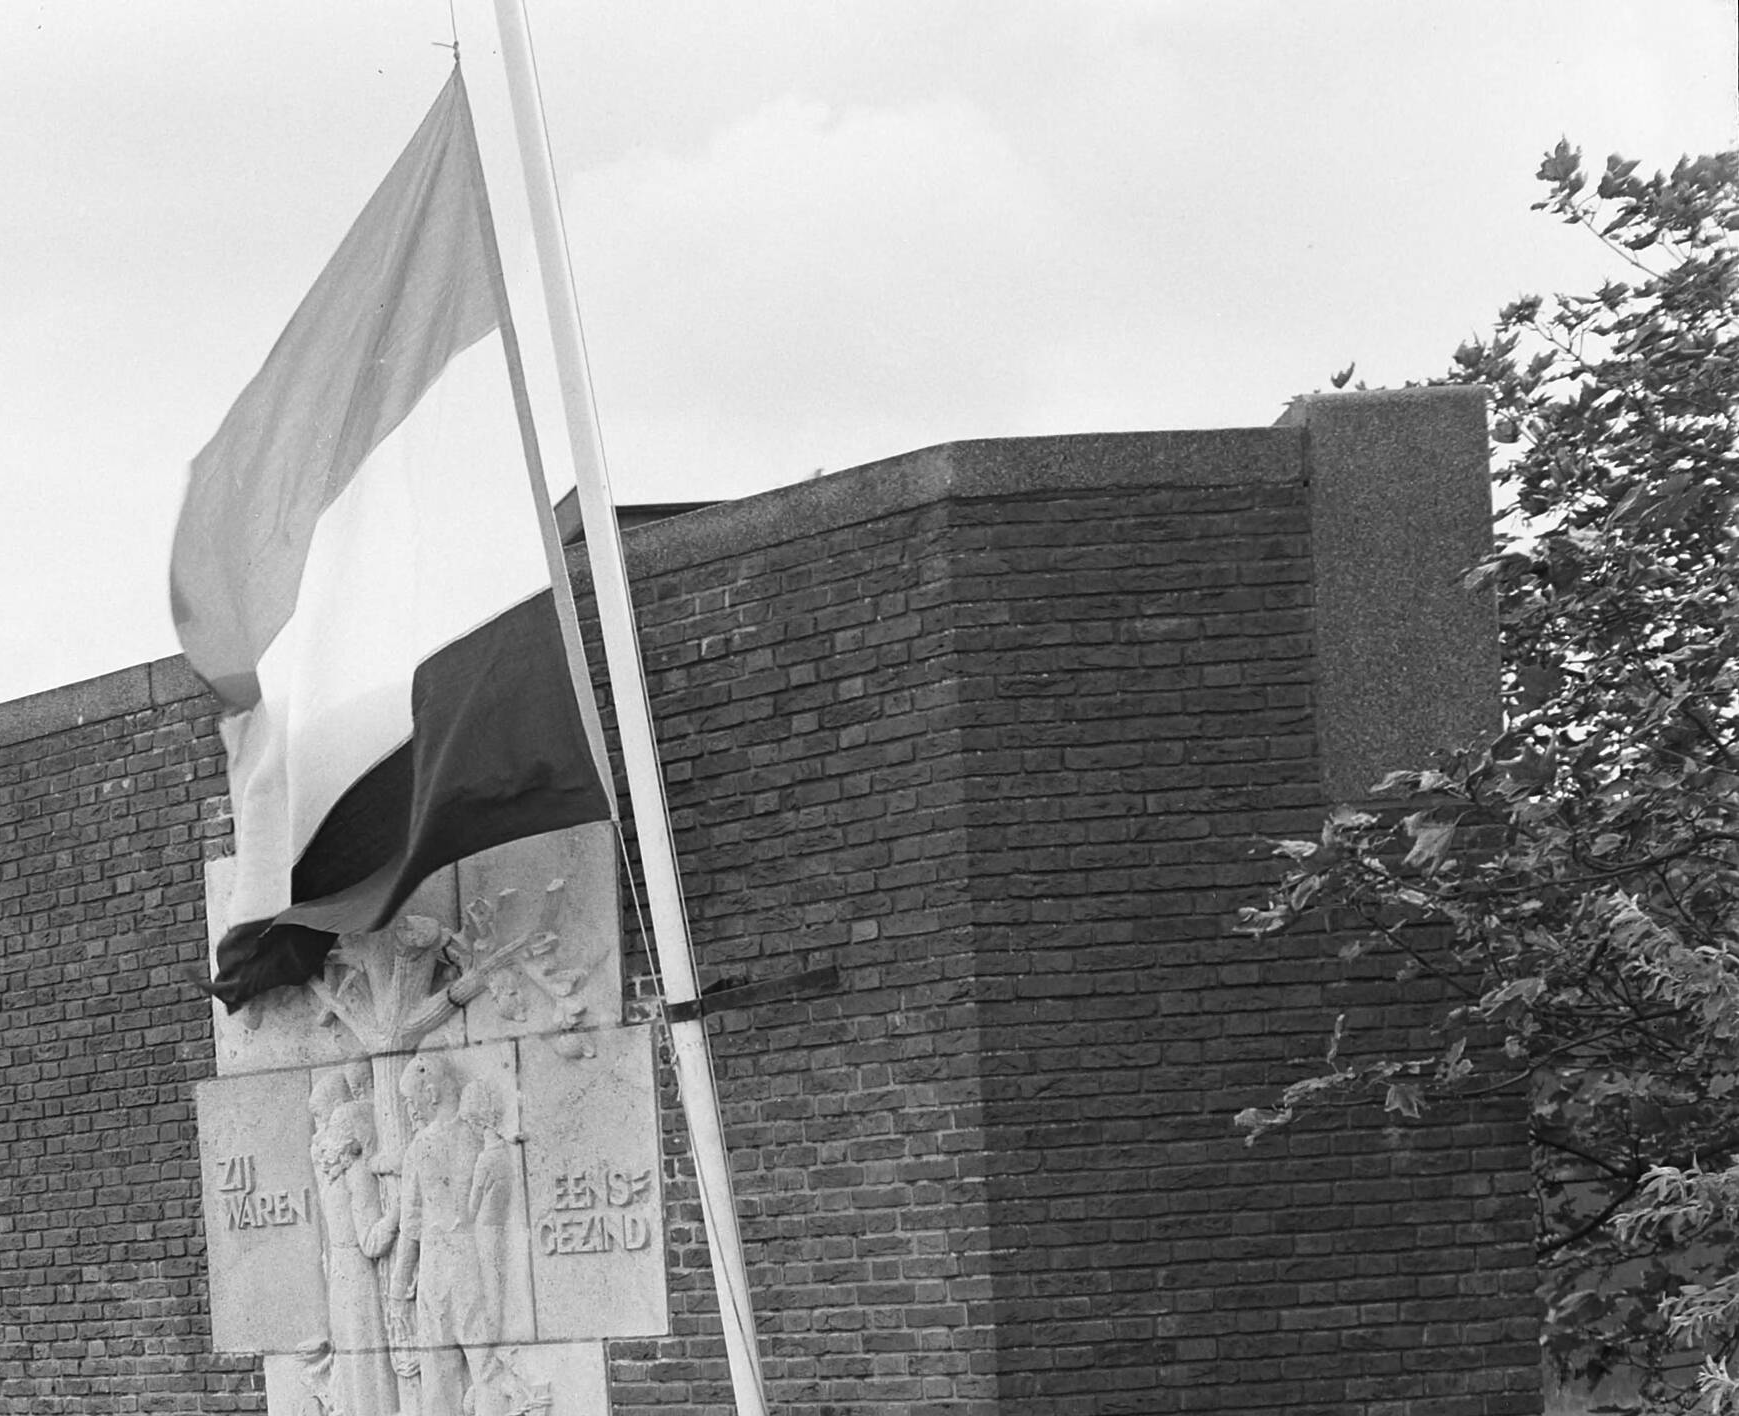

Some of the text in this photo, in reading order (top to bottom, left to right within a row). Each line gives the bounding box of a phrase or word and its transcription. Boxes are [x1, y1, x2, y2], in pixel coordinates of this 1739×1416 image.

[216, 1154, 257, 1196] ZIJ
[222, 1187, 312, 1231] WAREN
[538, 1213, 652, 1256] GEZIND
